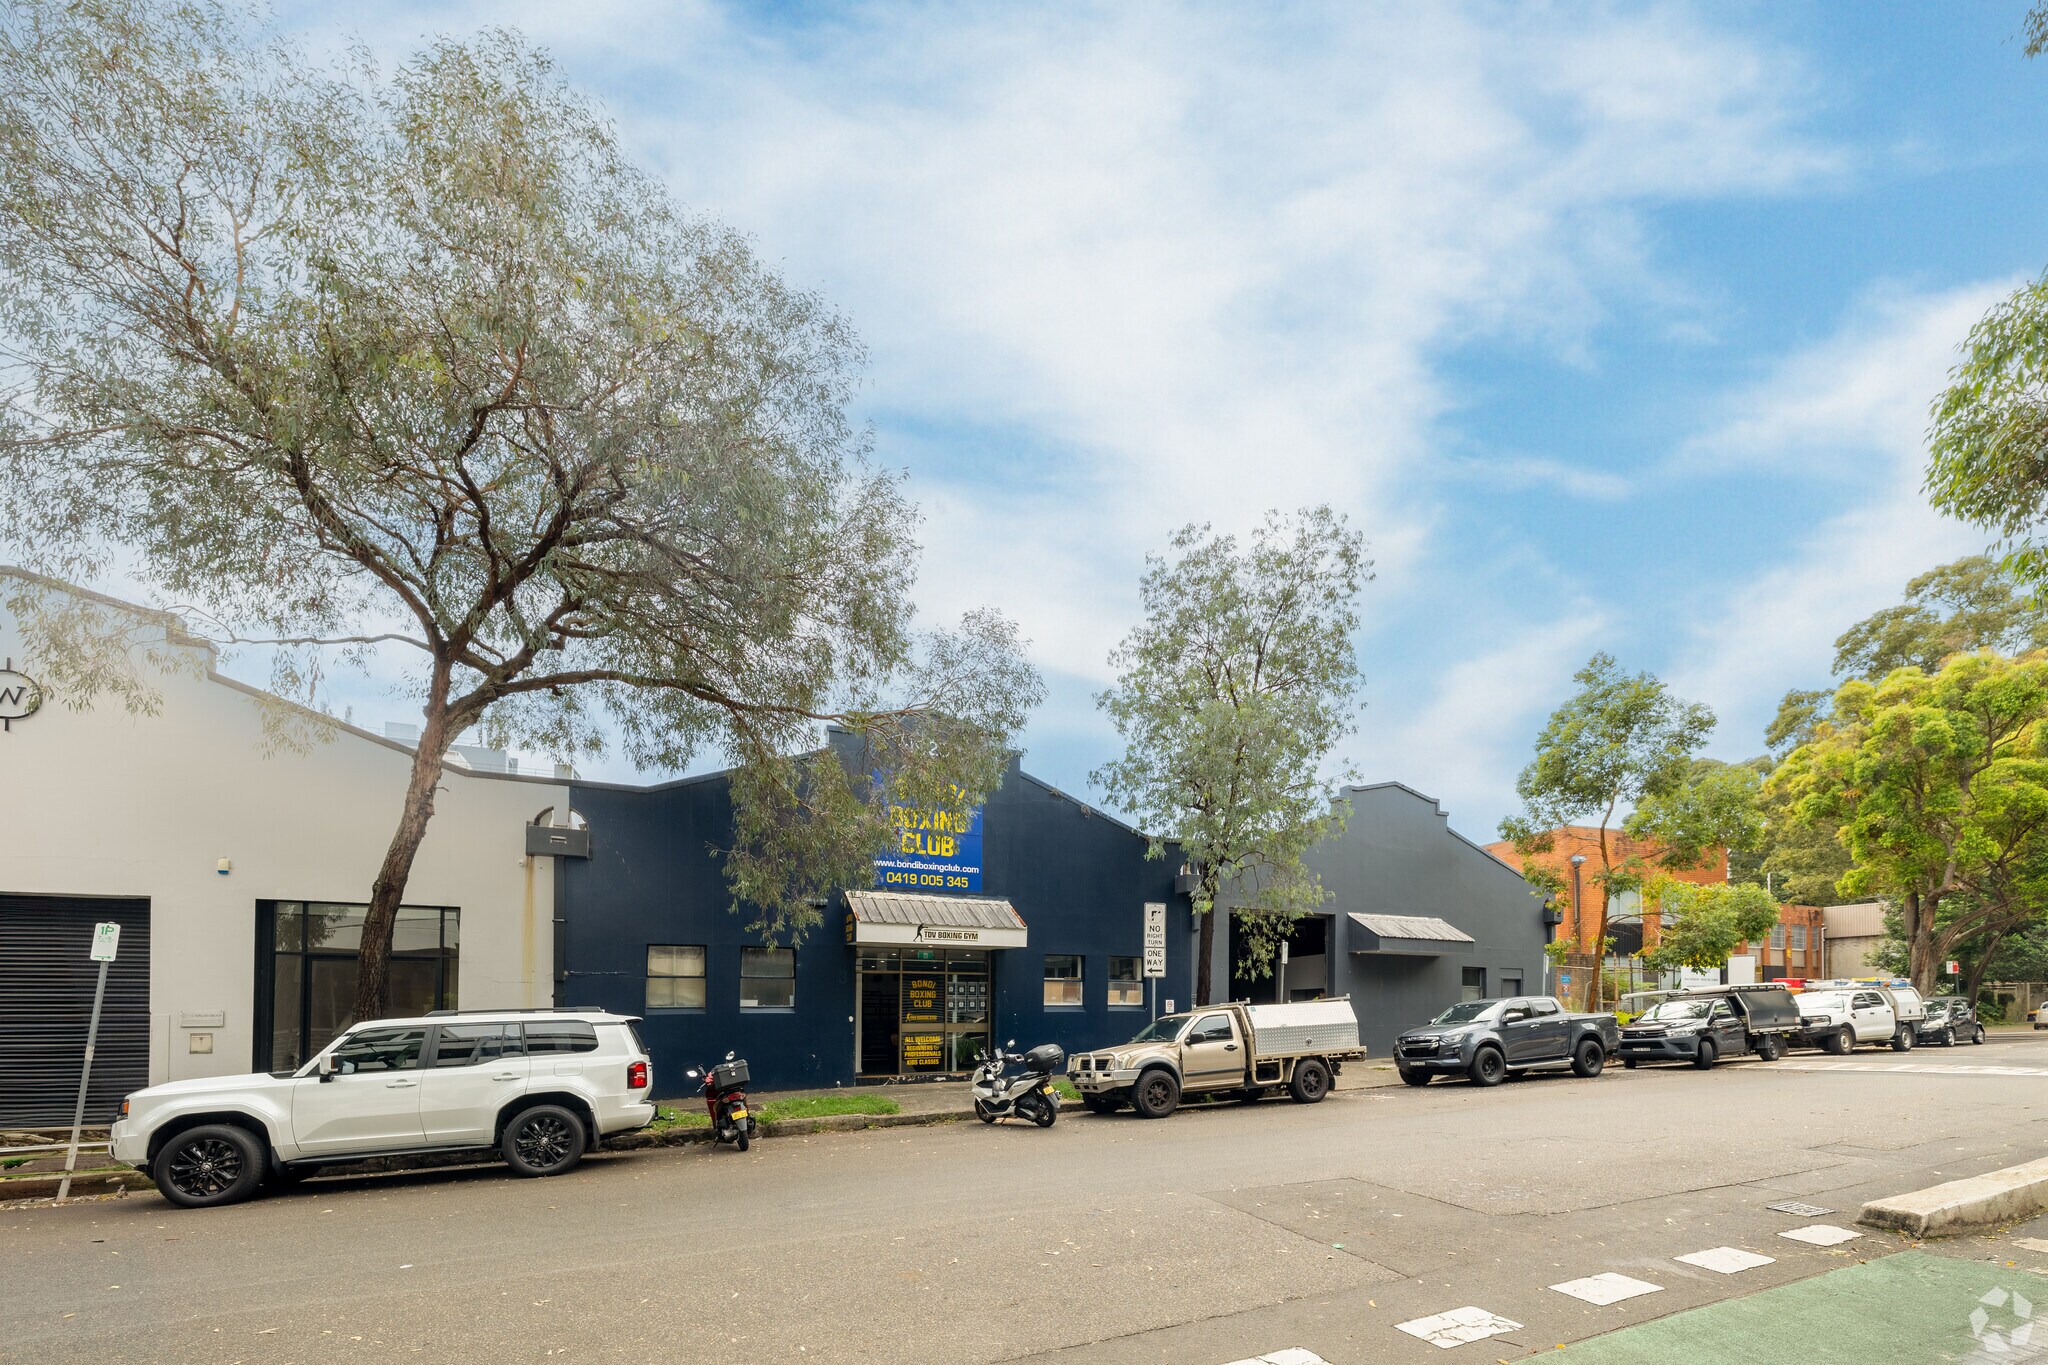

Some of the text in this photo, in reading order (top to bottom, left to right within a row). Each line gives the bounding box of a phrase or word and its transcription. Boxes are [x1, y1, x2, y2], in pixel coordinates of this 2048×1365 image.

[901, 832, 955, 857] CLUB
[873, 860, 979, 873] www.bondiboxingclub.com
[886, 871, 969, 888] 0419 005 345
[101, 926, 115, 935] 1P
[937, 931, 962, 940] BOXING
[963, 932, 978, 940] GYM
[911, 979, 936, 989] BONDI
[909, 990, 937, 999] BOXING
[913, 999, 932, 1007] CLUB
[914, 1035, 941, 1043] WELCOME
